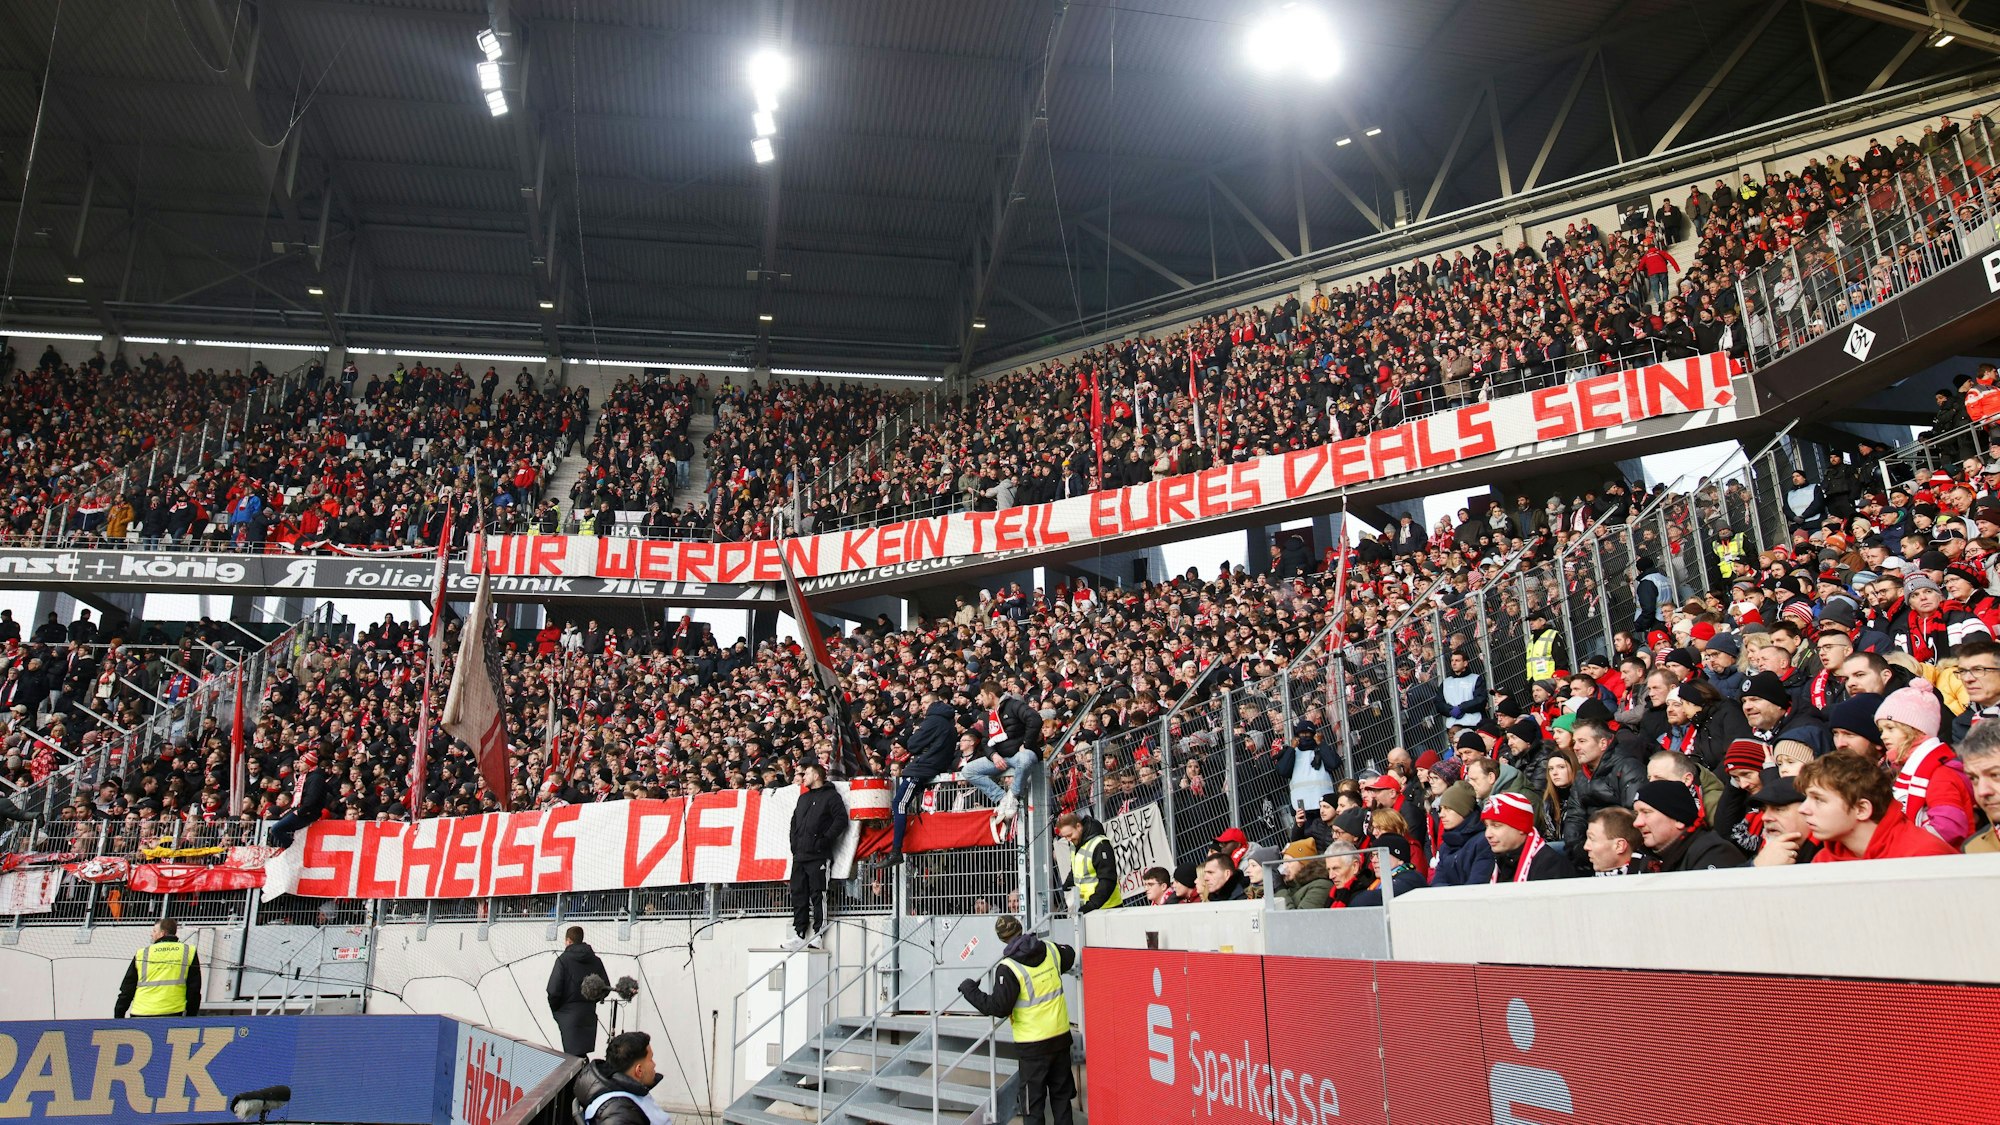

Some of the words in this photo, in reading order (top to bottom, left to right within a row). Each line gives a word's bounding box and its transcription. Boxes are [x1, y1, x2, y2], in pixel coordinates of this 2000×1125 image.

[471, 535, 568, 576] WIR
[596, 536, 819, 583] WERDEN
[840, 515, 949, 571] KEIN
[965, 503, 1070, 553] TEIL
[1090, 459, 1262, 537] EURES
[1284, 402, 1496, 499] DEALS
[1532, 351, 1736, 440] SEIN!
[120, 555, 246, 583] könig
[297, 804, 583, 898] SCHEISS
[623, 783, 809, 888] DFL
[1252, 918, 1259, 929] 23
[463, 1036, 524, 1125] hilzin
[1189, 1030, 1340, 1125] Sparkasse
